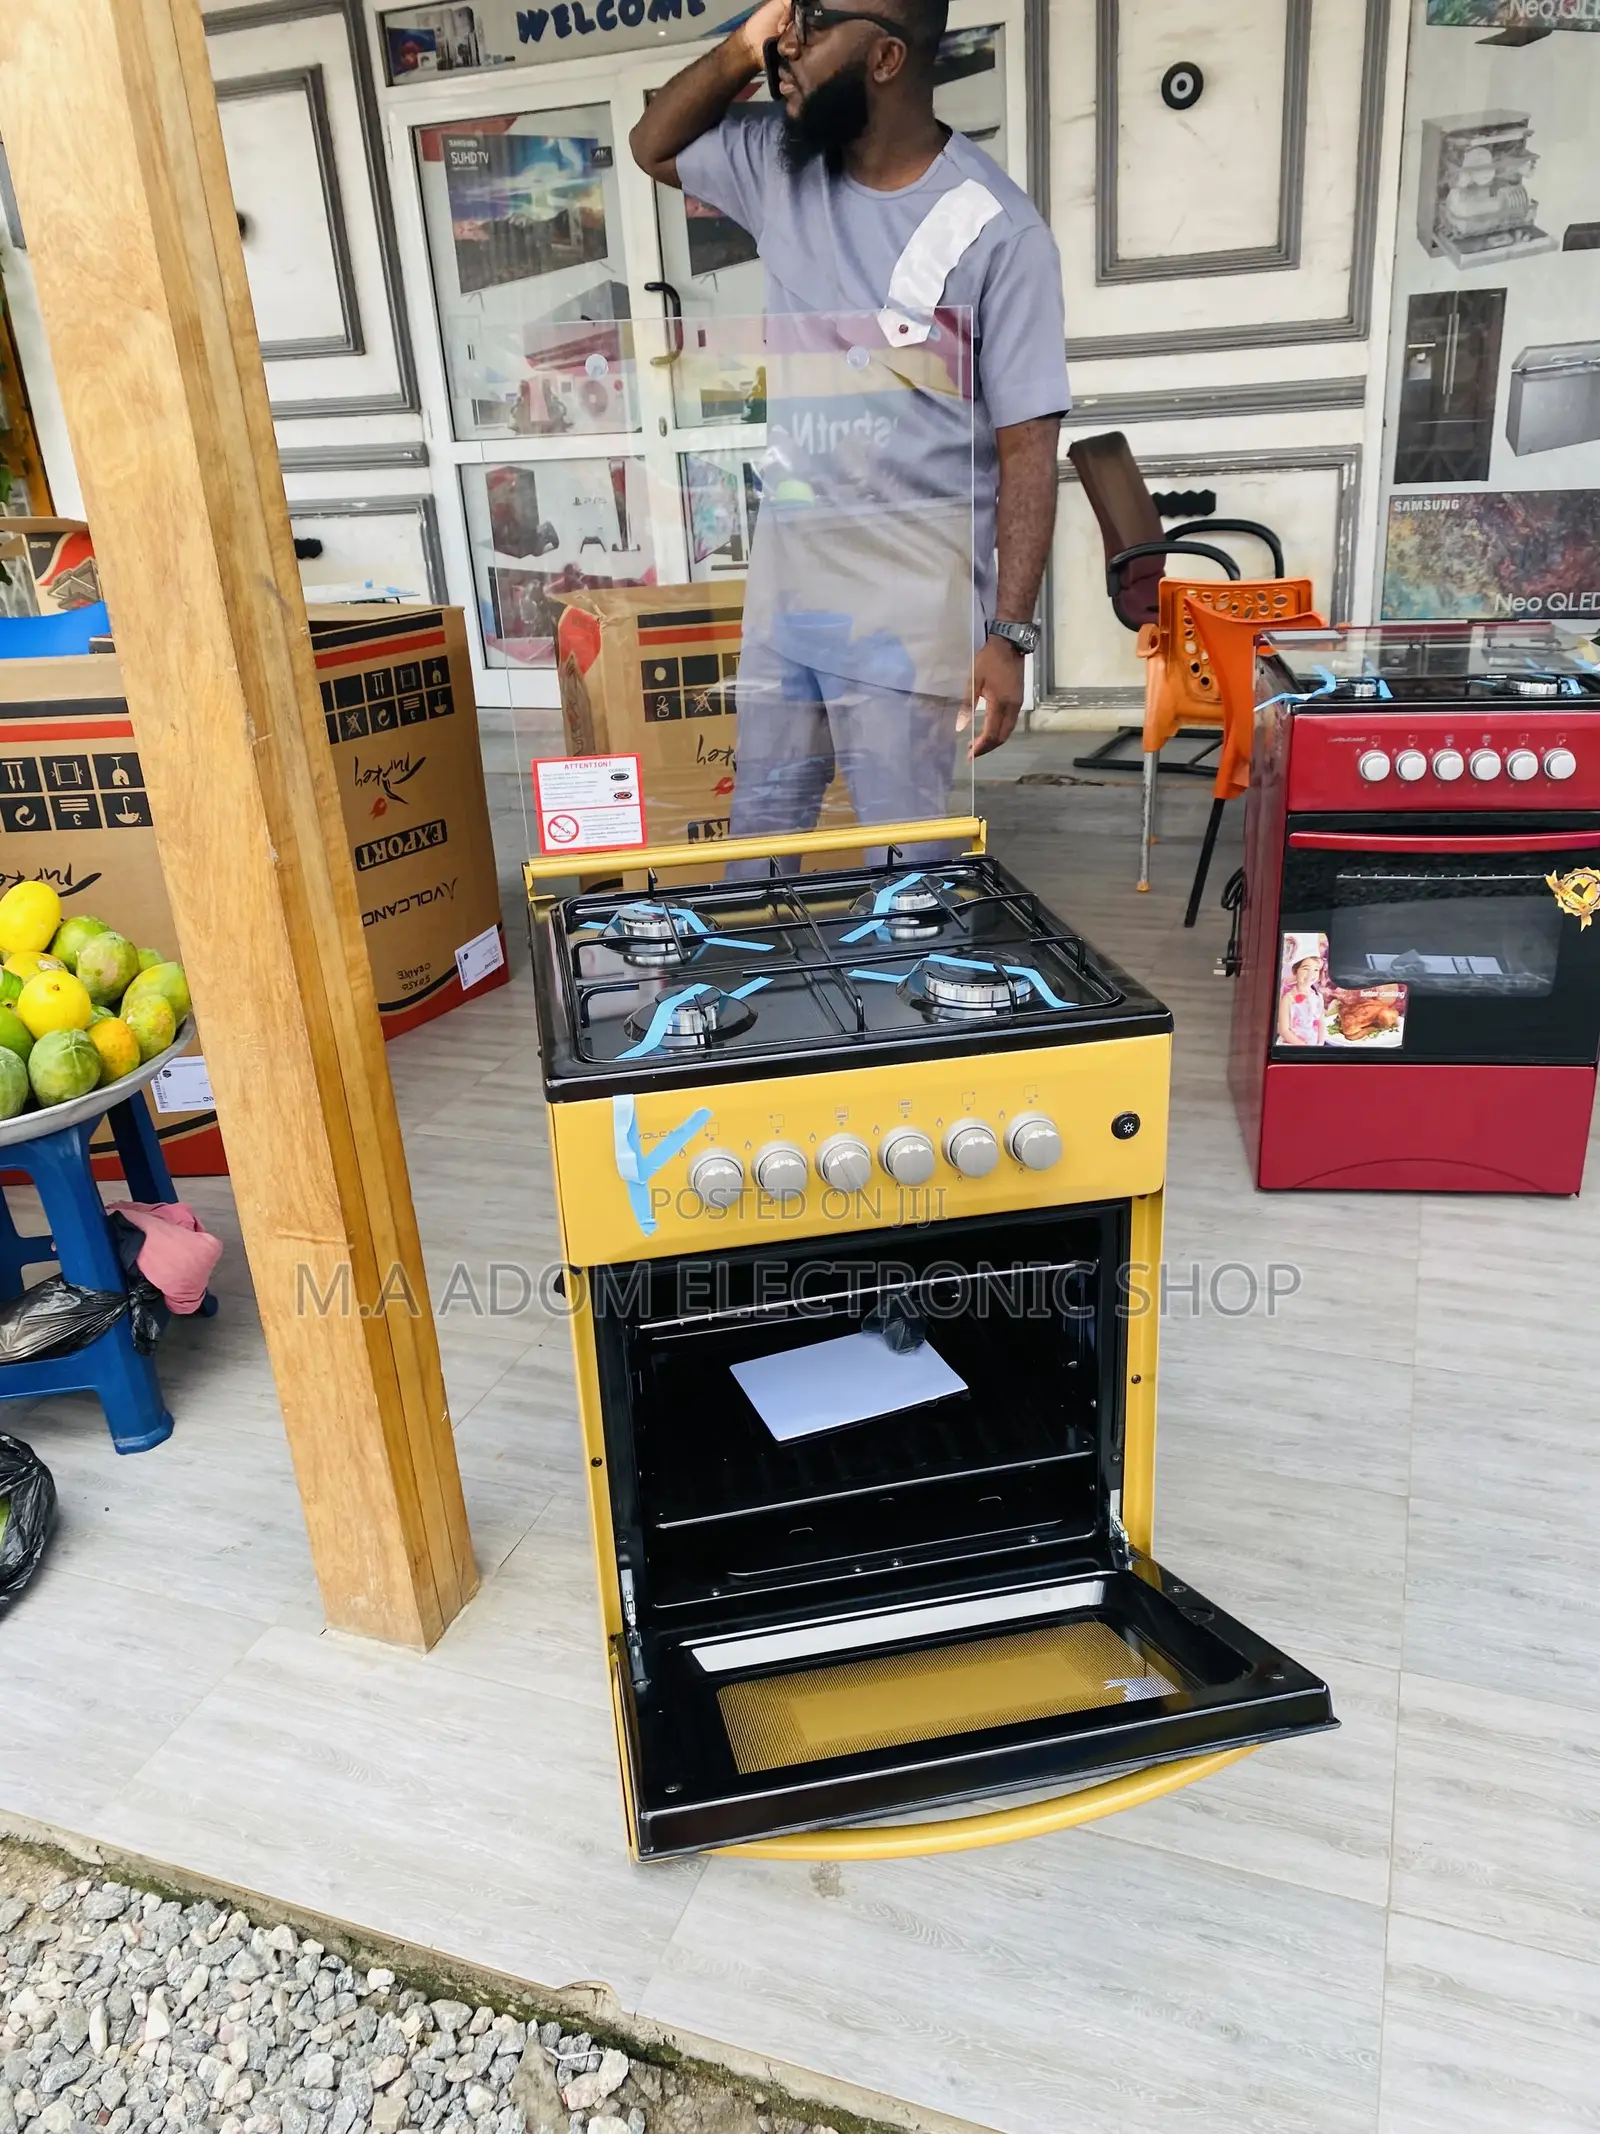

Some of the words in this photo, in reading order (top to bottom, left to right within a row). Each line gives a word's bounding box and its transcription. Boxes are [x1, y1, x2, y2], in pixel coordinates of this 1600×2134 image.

[1510, 0, 1554, 18] Neo
[1394, 499, 1460, 512] SAMSUNG
[1495, 592, 1542, 612] Neo
[564, 761, 612, 770] ATTENTION!
[360, 822, 444, 869] EXPORT
